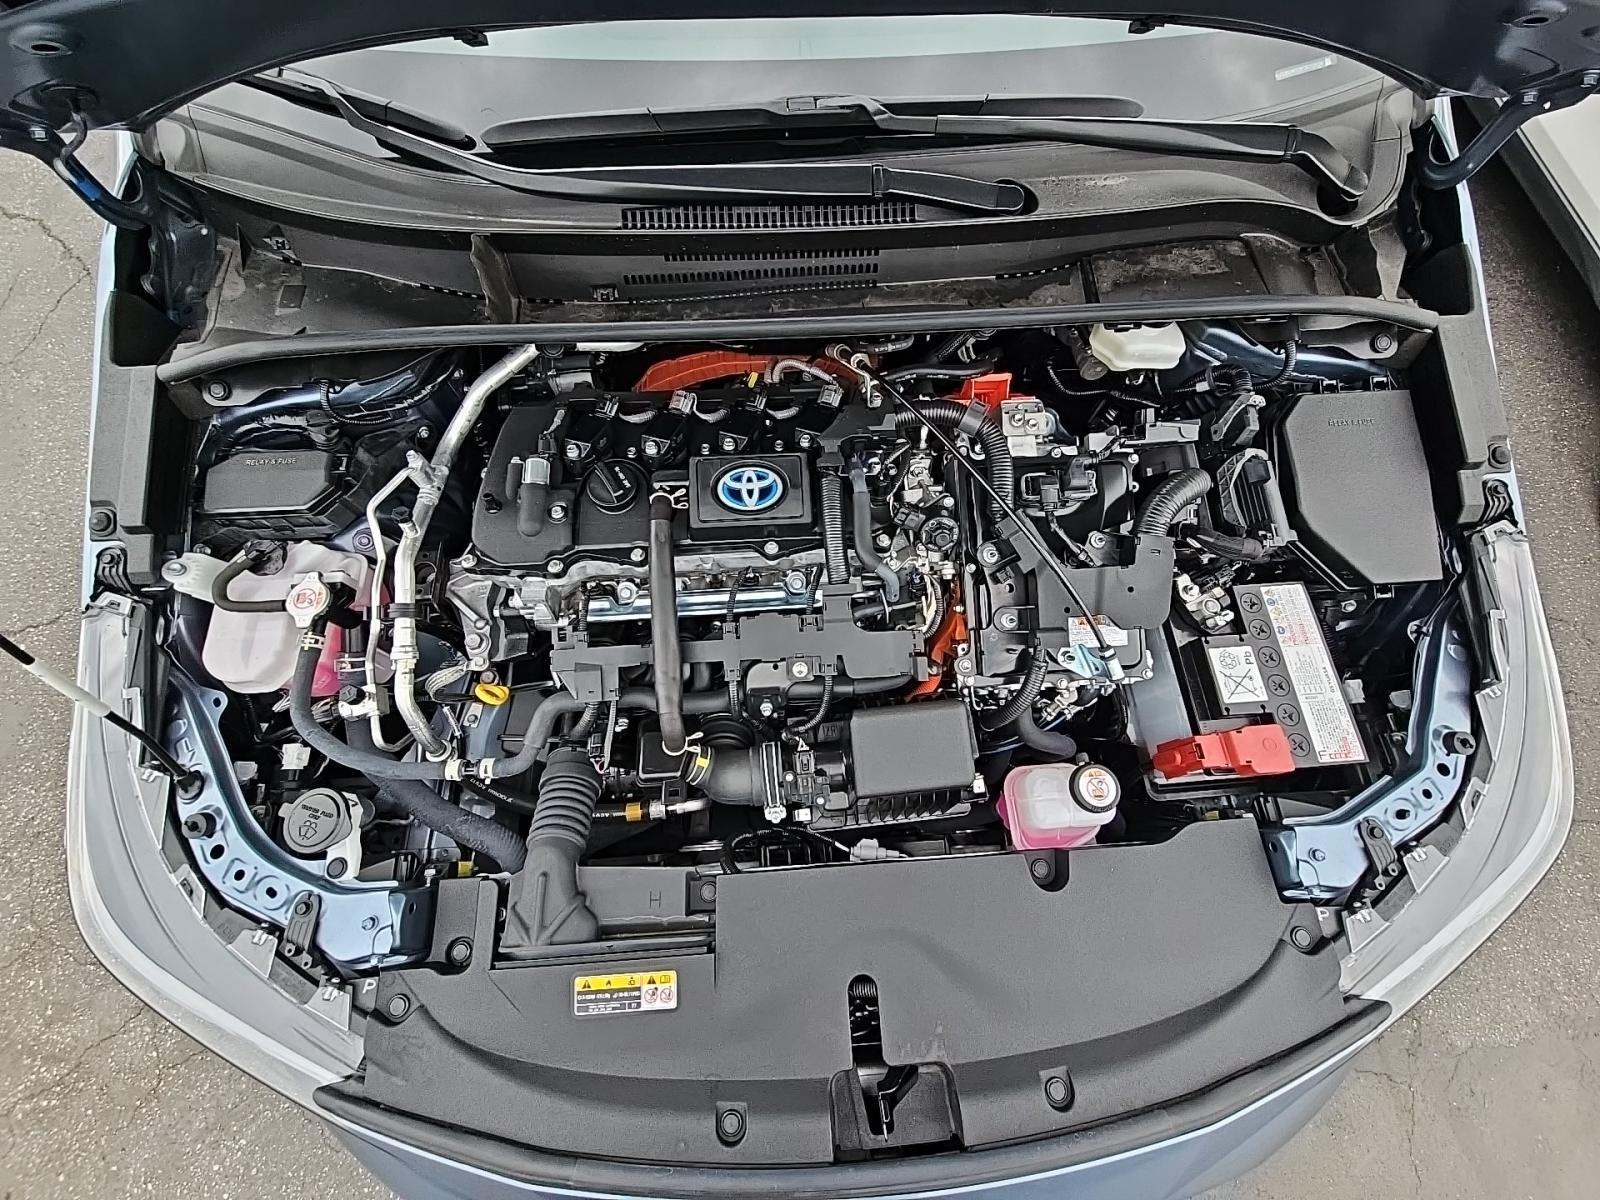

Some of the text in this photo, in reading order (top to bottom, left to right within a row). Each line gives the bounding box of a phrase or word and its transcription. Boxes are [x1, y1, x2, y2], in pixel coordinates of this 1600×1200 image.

[246, 458, 270, 466] RELAY
[278, 457, 297, 465] FUSE
[1244, 651, 1253, 664] Pb
[649, 890, 662, 909] H
[1317, 907, 1330, 922] P
[362, 979, 377, 994] P
